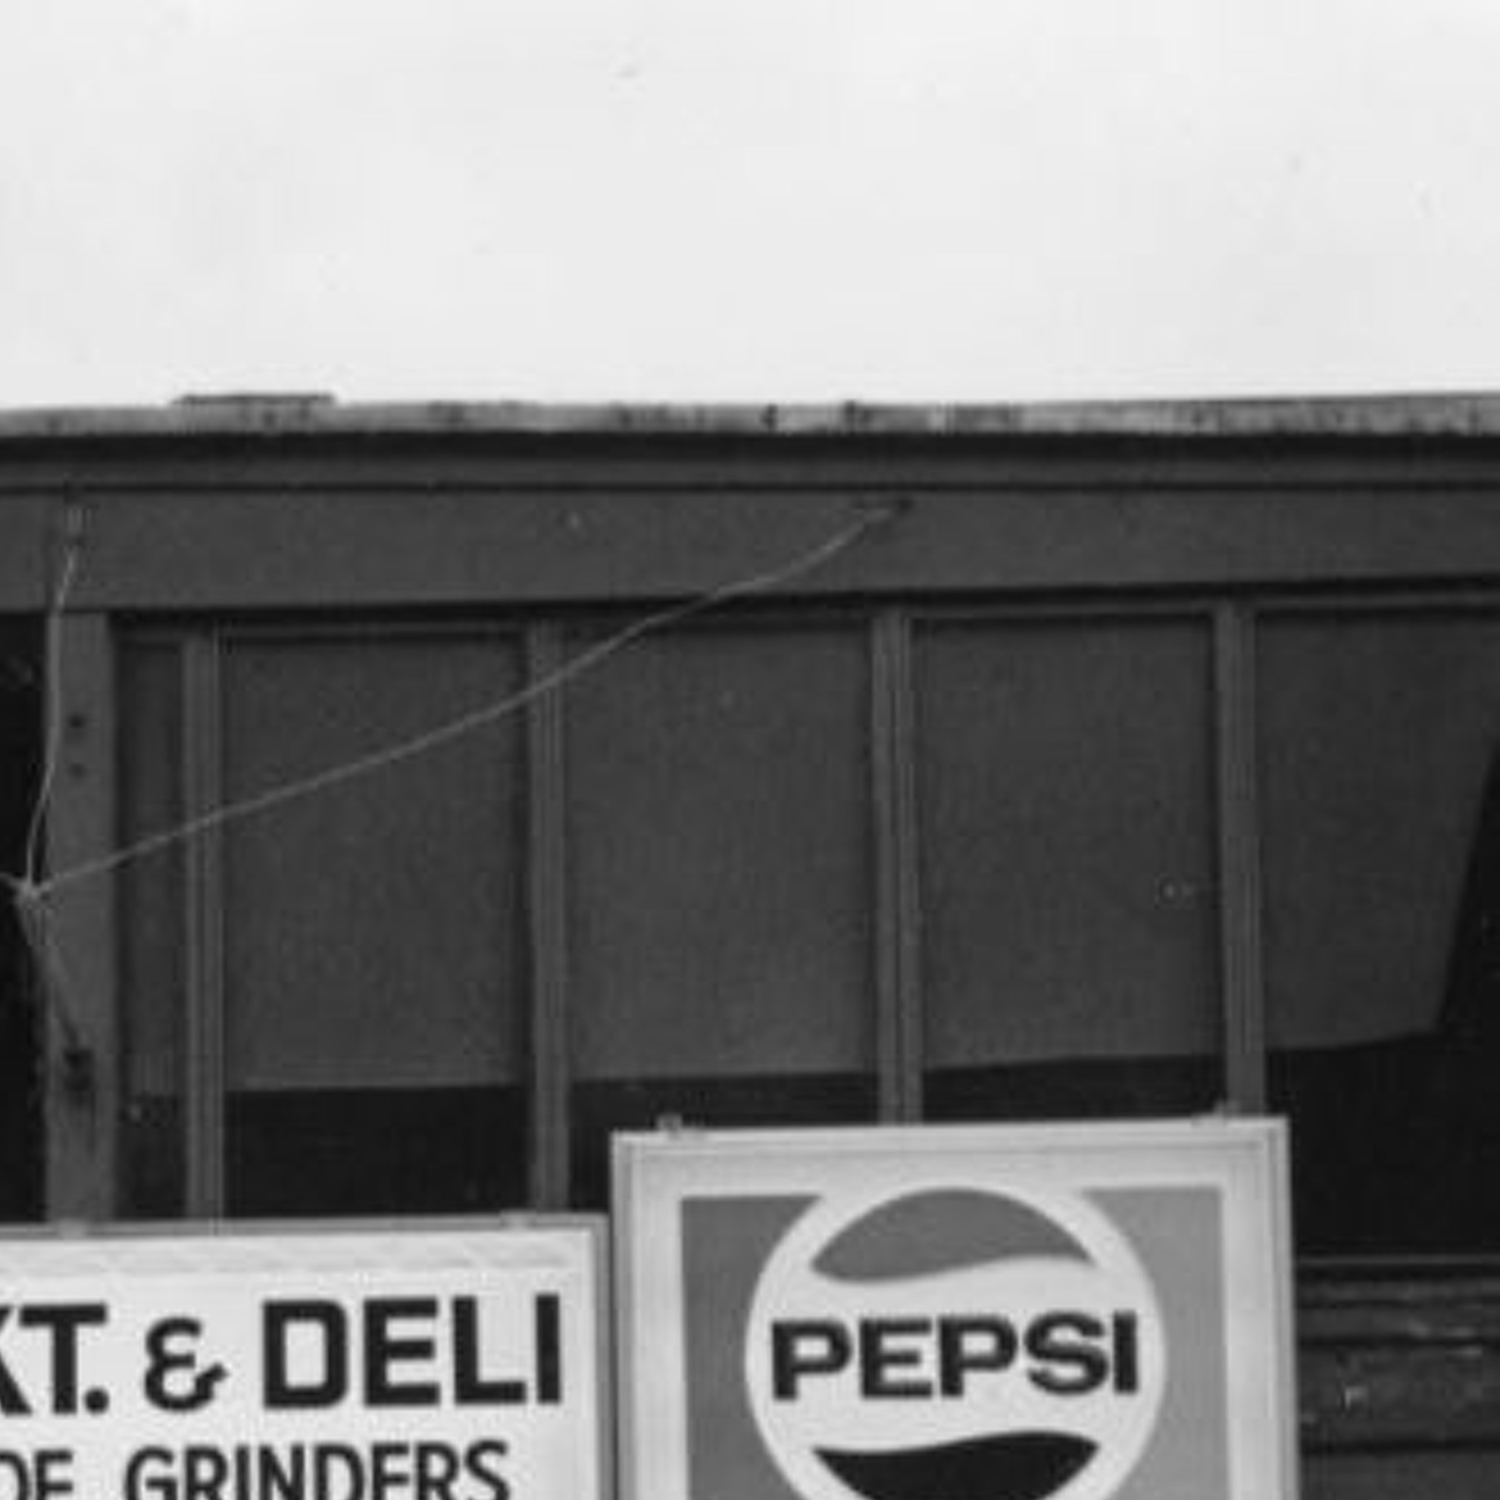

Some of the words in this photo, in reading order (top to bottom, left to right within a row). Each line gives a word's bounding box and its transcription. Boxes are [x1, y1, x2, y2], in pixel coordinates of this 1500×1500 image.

[143, 1316, 228, 1413] &
[261, 1292, 562, 1411] DELI
[770, 1310, 1139, 1402] PEPSI
